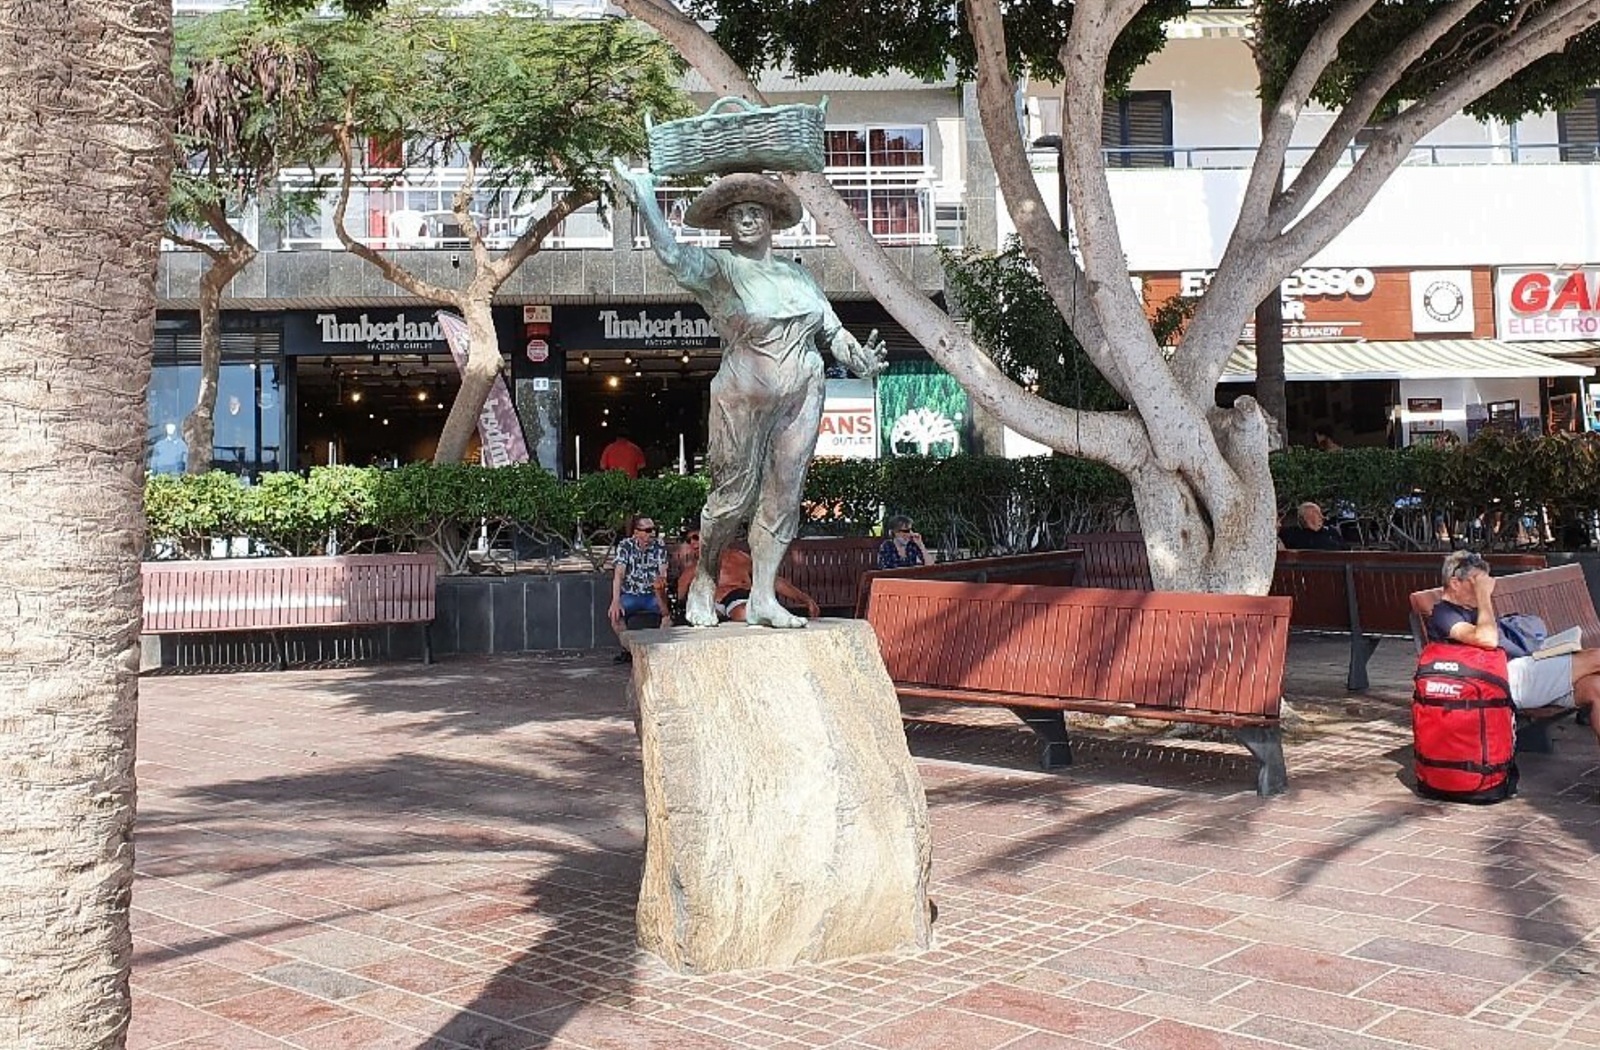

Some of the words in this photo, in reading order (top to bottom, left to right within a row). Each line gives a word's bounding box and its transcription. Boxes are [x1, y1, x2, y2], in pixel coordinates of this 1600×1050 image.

[1511, 272, 1600, 311] GA
[1301, 327, 1343, 337] BAKERY
[1509, 317, 1600, 334] ELECTRO
[819, 415, 872, 435] ANS
[832, 436, 872, 446] OUTLET
